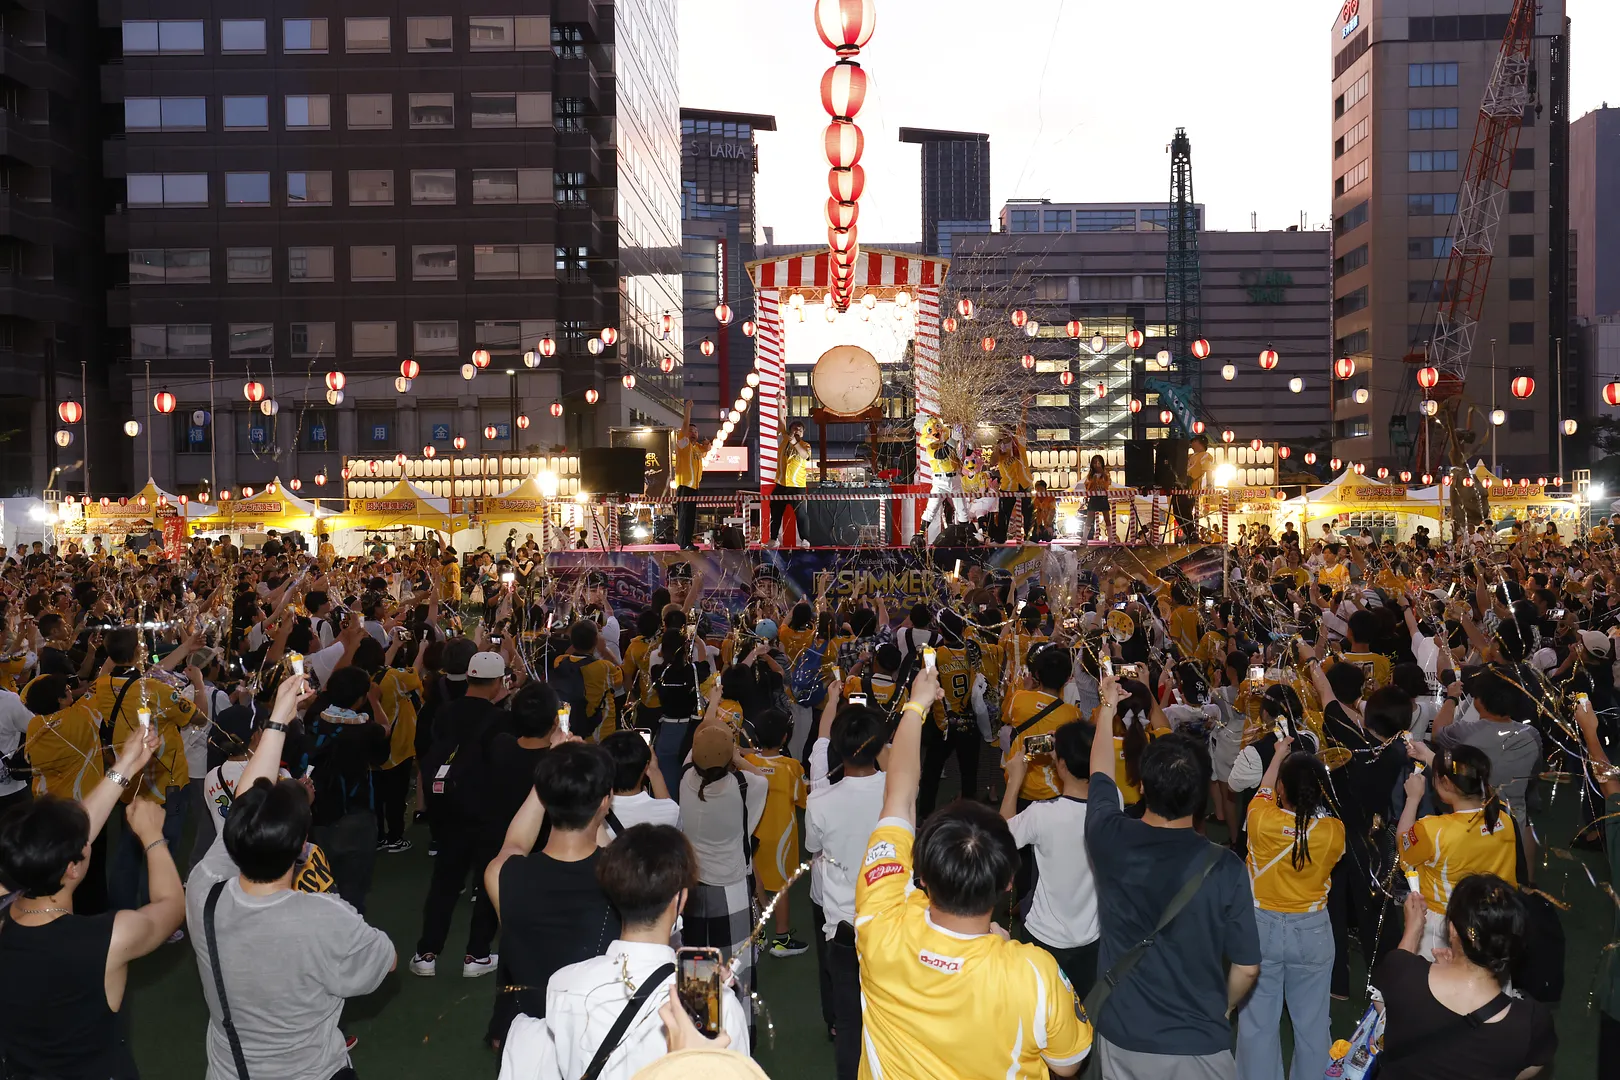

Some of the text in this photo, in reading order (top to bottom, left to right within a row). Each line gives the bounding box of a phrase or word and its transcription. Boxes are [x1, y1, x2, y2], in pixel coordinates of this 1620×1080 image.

[691, 140, 746, 159] SLARIA
[838, 570, 937, 595] SUMMER
[952, 673, 968, 699] 9
[920, 955, 959, 971] ロックアイス
